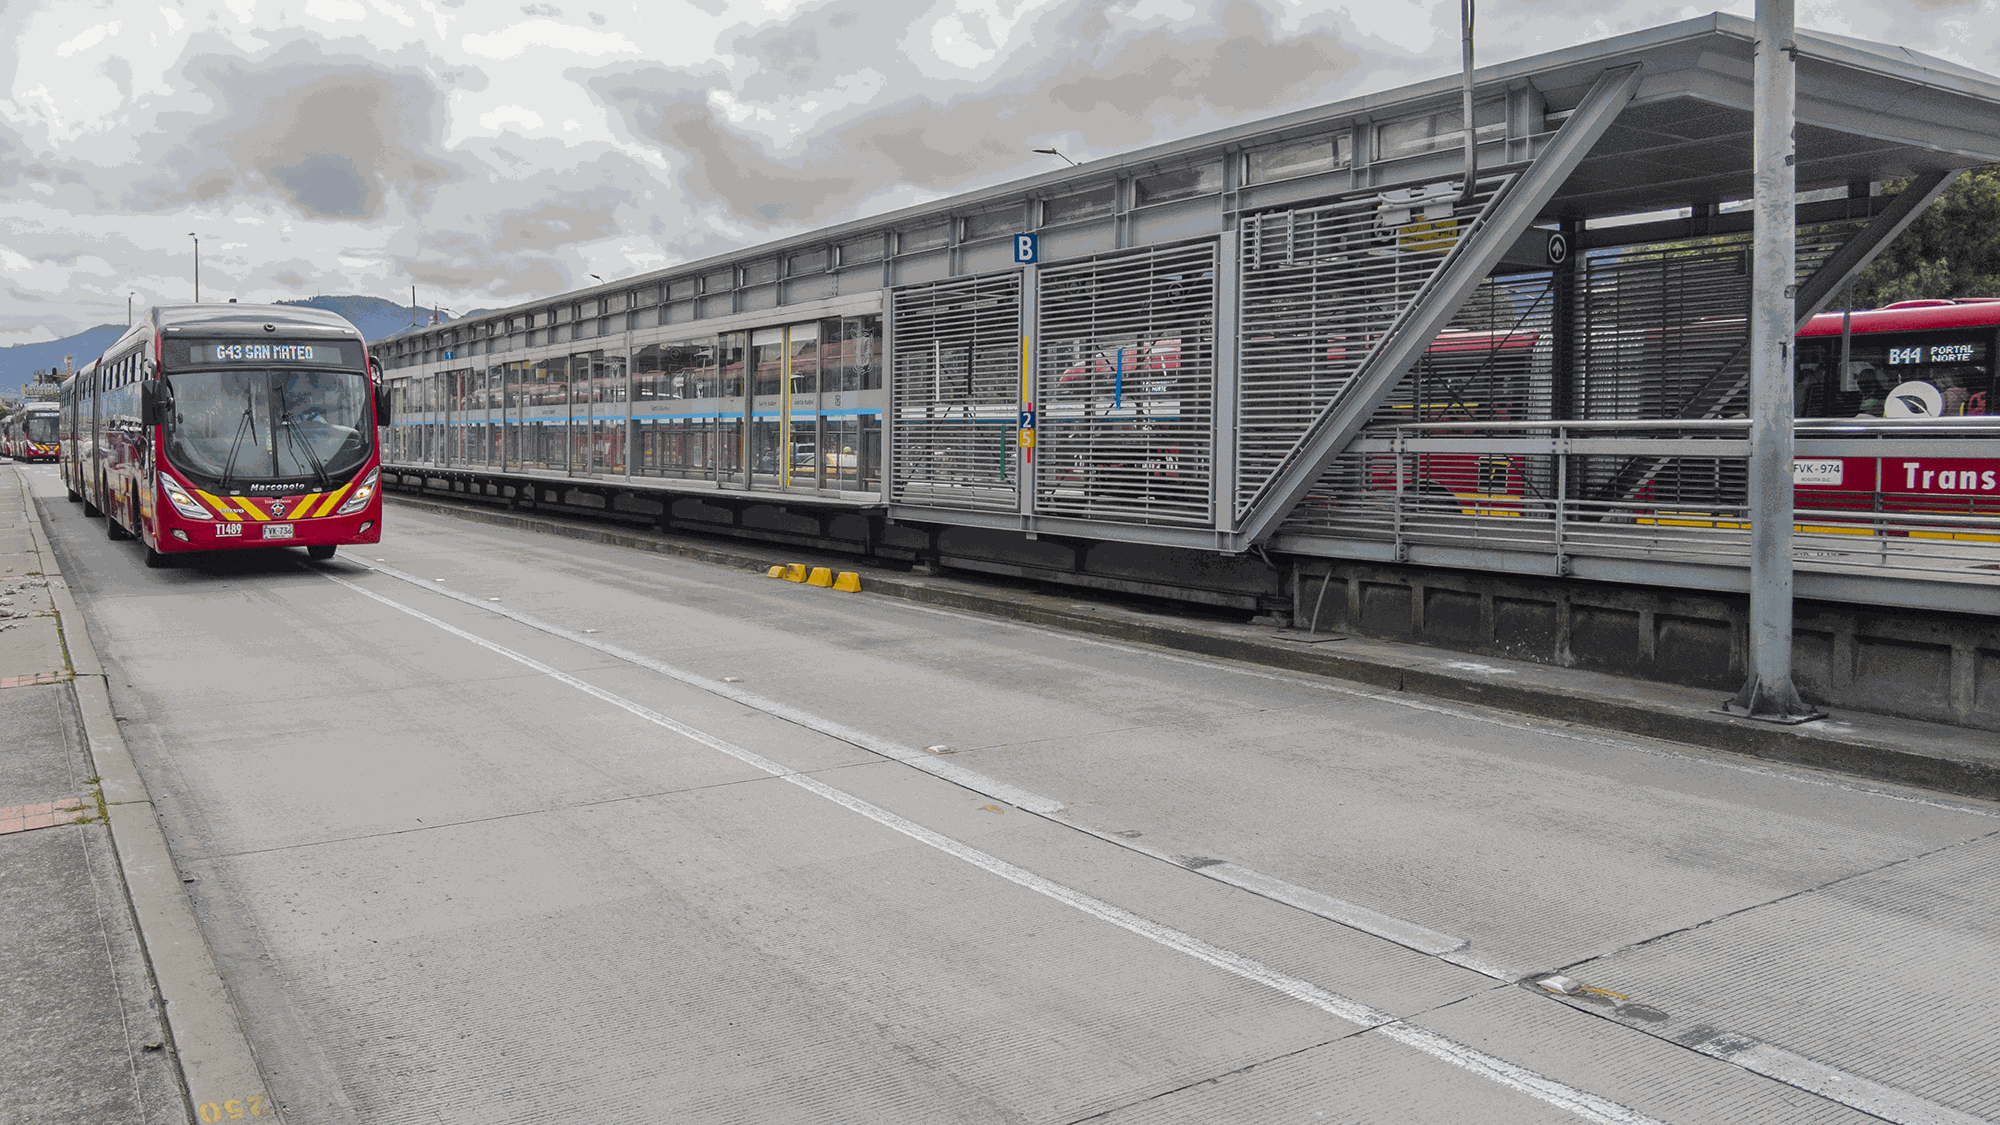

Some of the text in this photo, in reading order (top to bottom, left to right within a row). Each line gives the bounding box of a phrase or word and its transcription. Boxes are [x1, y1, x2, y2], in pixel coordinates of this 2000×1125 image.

[1018, 236, 1033, 260] B
[216, 345, 313, 360] G43 SAN MATEO
[1889, 346, 1922, 365] B44
[1931, 345, 1974, 355] PORTAL
[1931, 353, 1970, 362] NORTE
[1022, 412, 1032, 428] 2
[1022, 431, 1031, 446] 5
[1793, 464, 1841, 473] FVK-974
[1903, 462, 1997, 490] Trans
[250, 482, 305, 491] Marcopolo
[215, 523, 242, 535] T1489
